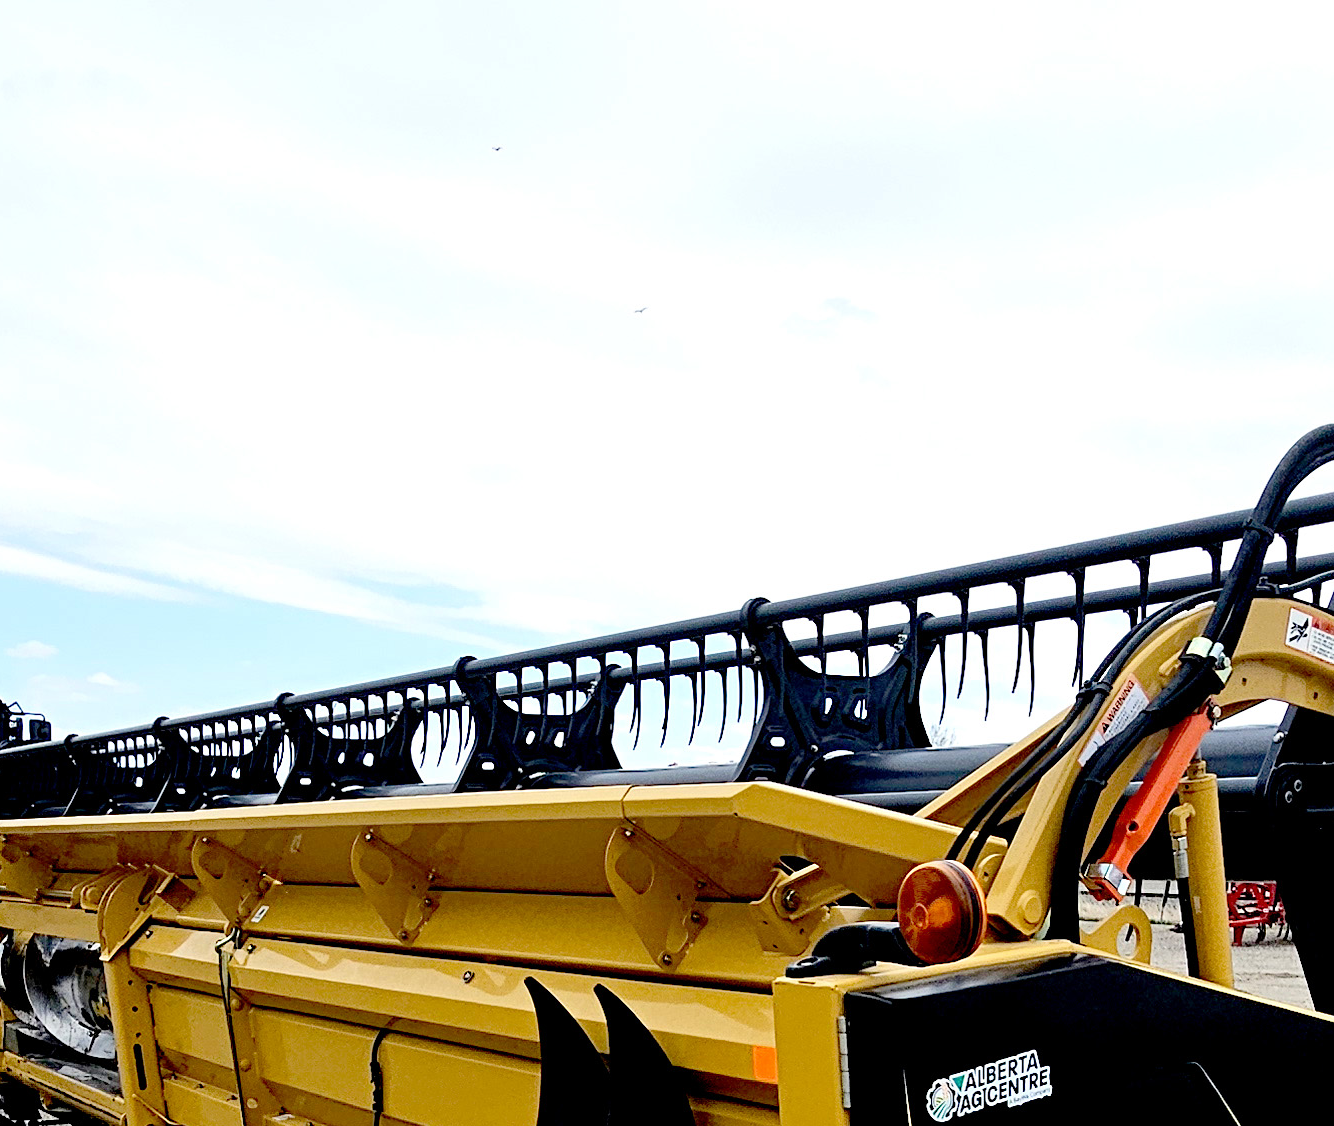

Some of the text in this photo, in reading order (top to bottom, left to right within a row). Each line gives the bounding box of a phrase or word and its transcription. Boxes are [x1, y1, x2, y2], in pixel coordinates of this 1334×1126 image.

[1107, 680, 1135, 722] WARNING
[959, 1068, 1048, 1114] AG CENTRE
[965, 1051, 1039, 1092] ALBERTA
